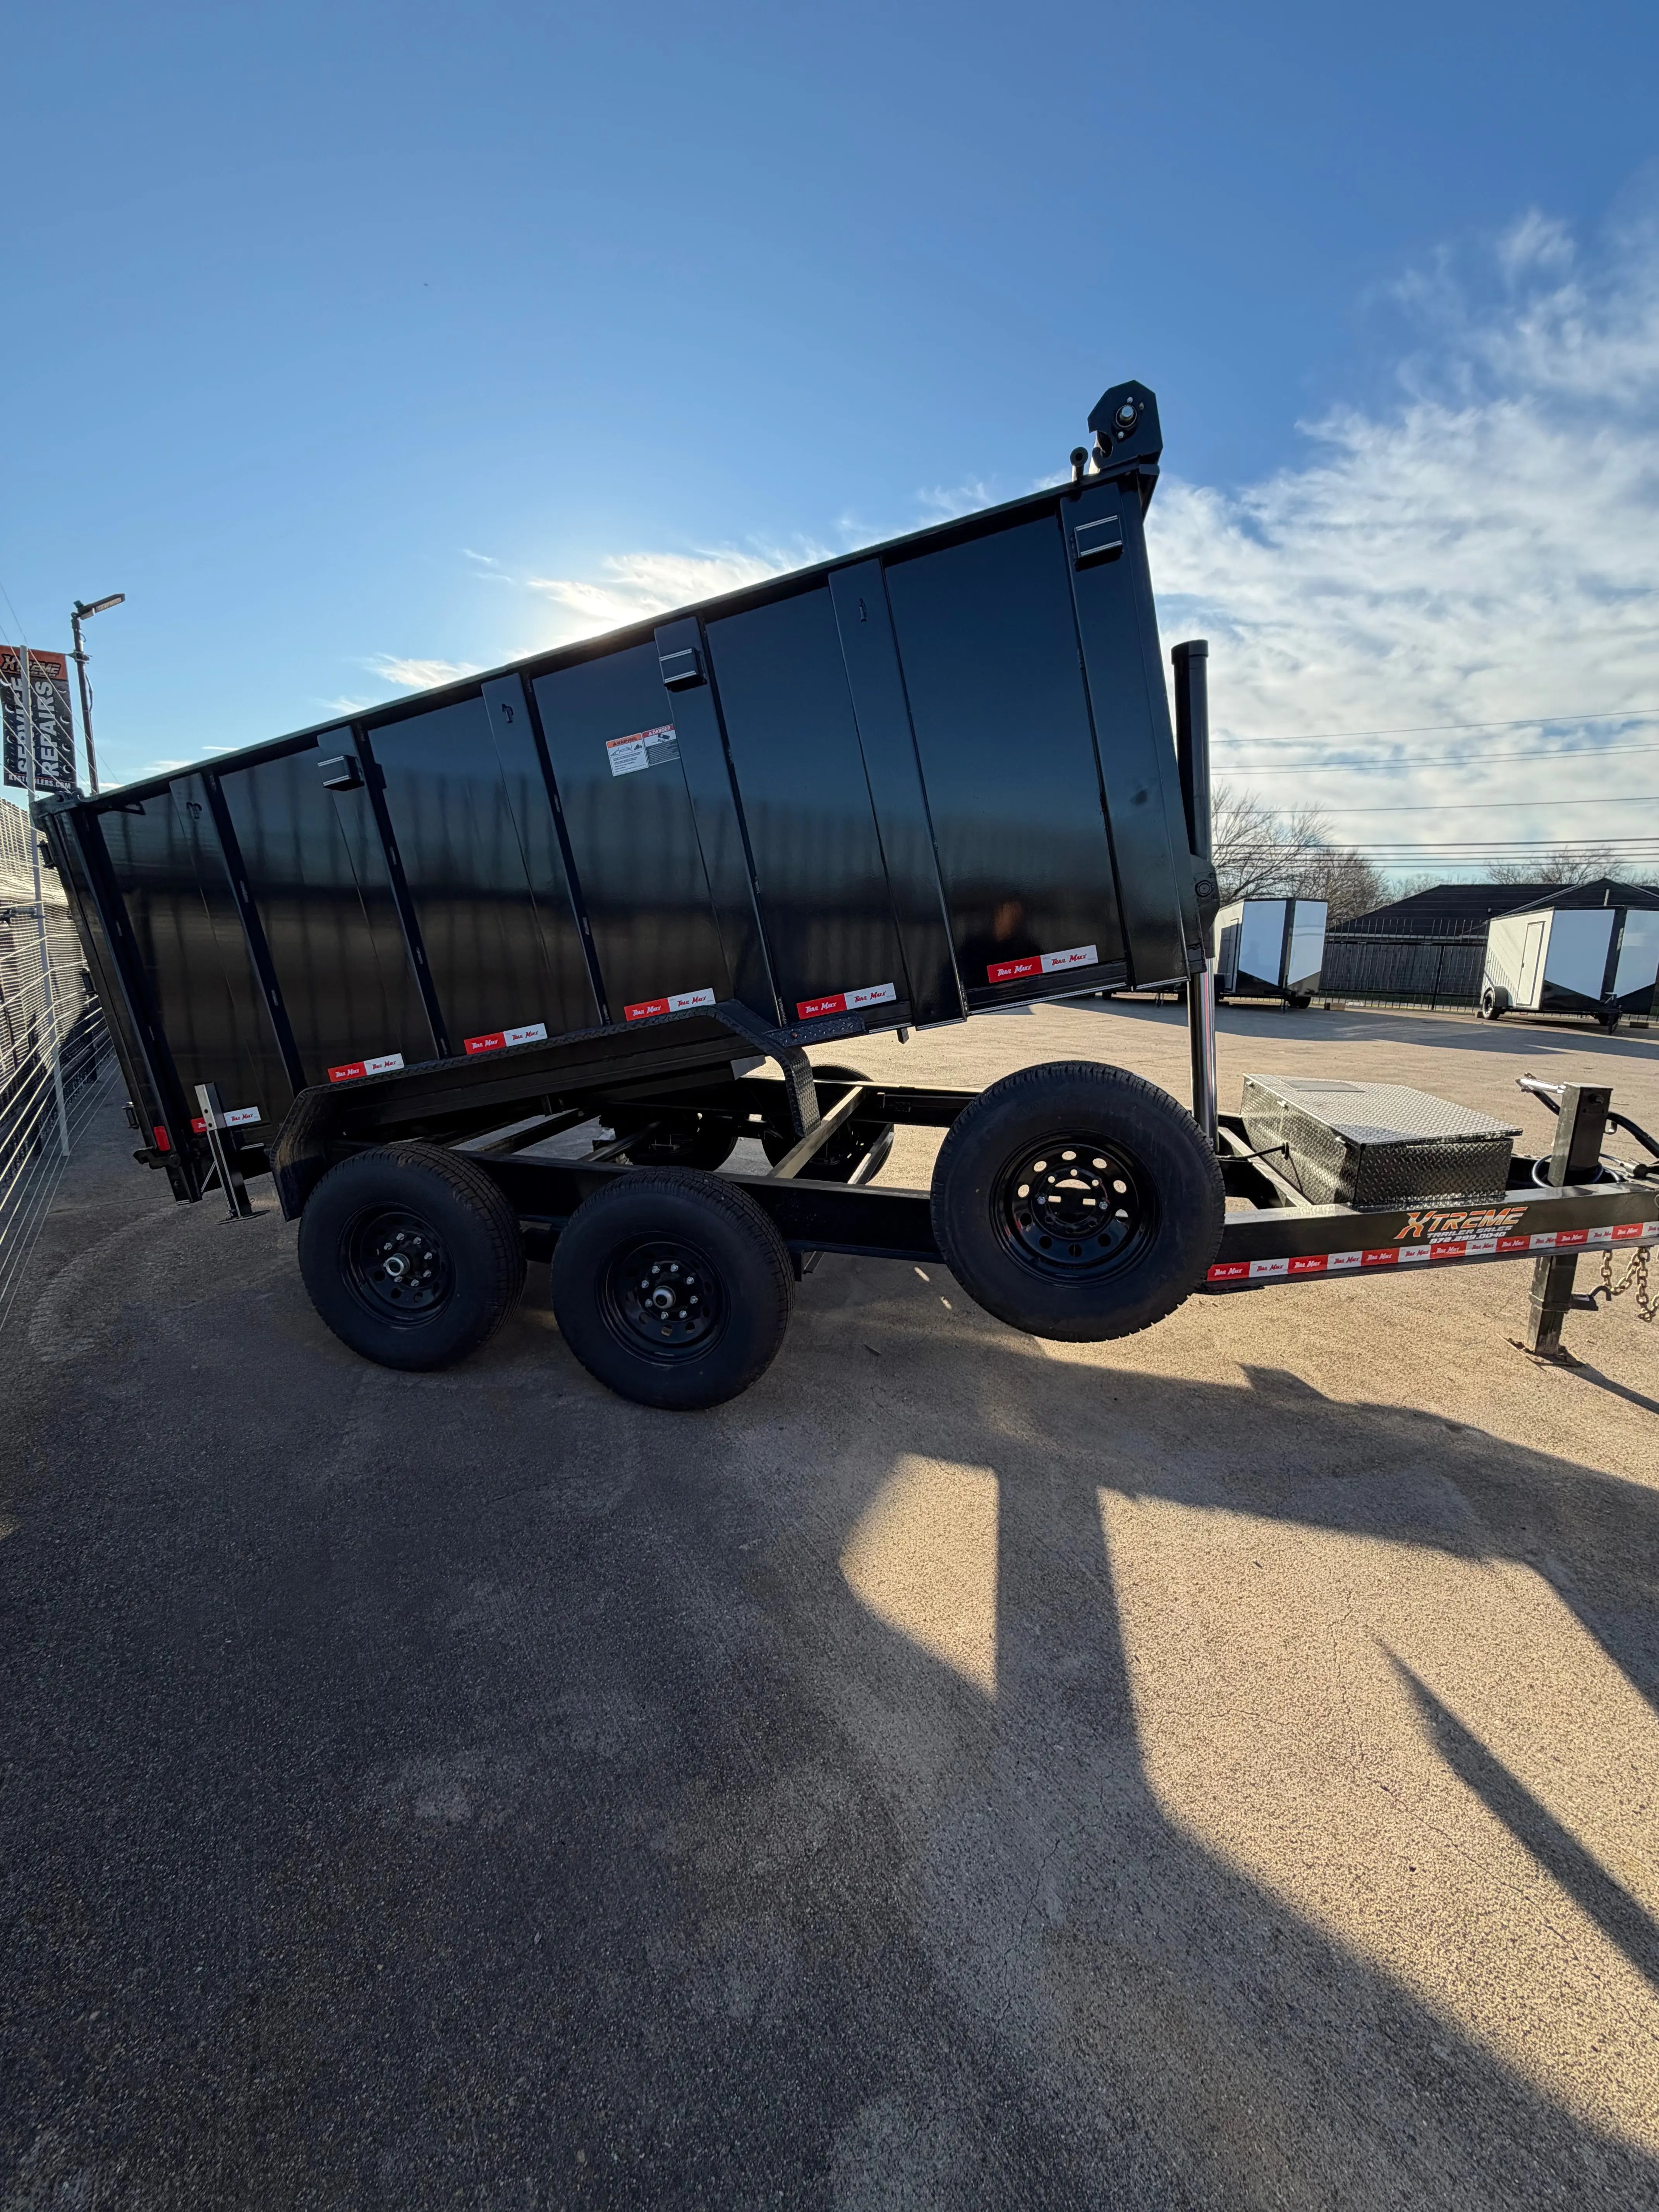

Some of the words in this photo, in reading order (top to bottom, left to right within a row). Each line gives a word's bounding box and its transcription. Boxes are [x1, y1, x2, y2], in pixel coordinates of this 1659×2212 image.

[35, 681, 59, 776] REPAIRS
[653, 726, 670, 735] DANGER
[617, 737, 637, 745] WARNING
[1393, 1206, 1528, 1239] XTREME
[1427, 1229, 1474, 1238] TRAILER
[1428, 1231, 1506, 1244] 972.299.0040
